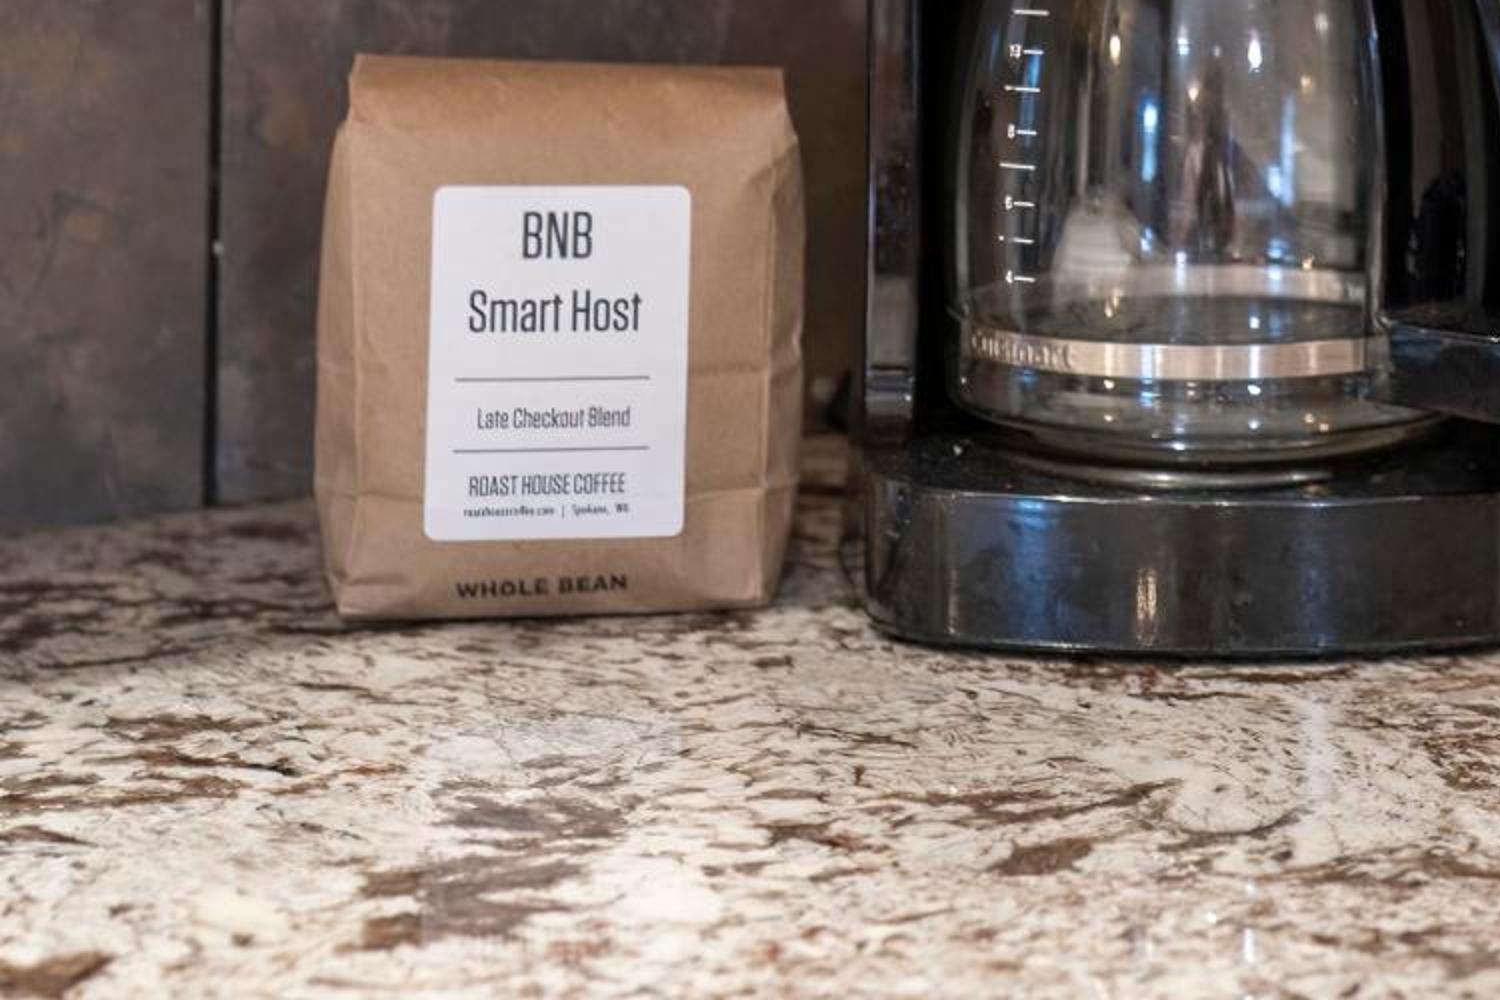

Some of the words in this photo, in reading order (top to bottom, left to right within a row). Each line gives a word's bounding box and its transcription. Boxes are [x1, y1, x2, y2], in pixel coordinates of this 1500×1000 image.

[521, 210, 593, 260] BNB
[468, 289, 564, 334] Smart
[571, 289, 644, 333] Host
[476, 407, 510, 430] Late
[512, 406, 585, 430] Checkout
[587, 405, 631, 428] Blend
[468, 474, 519, 497] ROAST
[521, 473, 571, 496] HOUSE
[573, 471, 626, 495] COFFEE
[455, 577, 549, 598] WHOLE
[558, 574, 628, 595] BEAN
